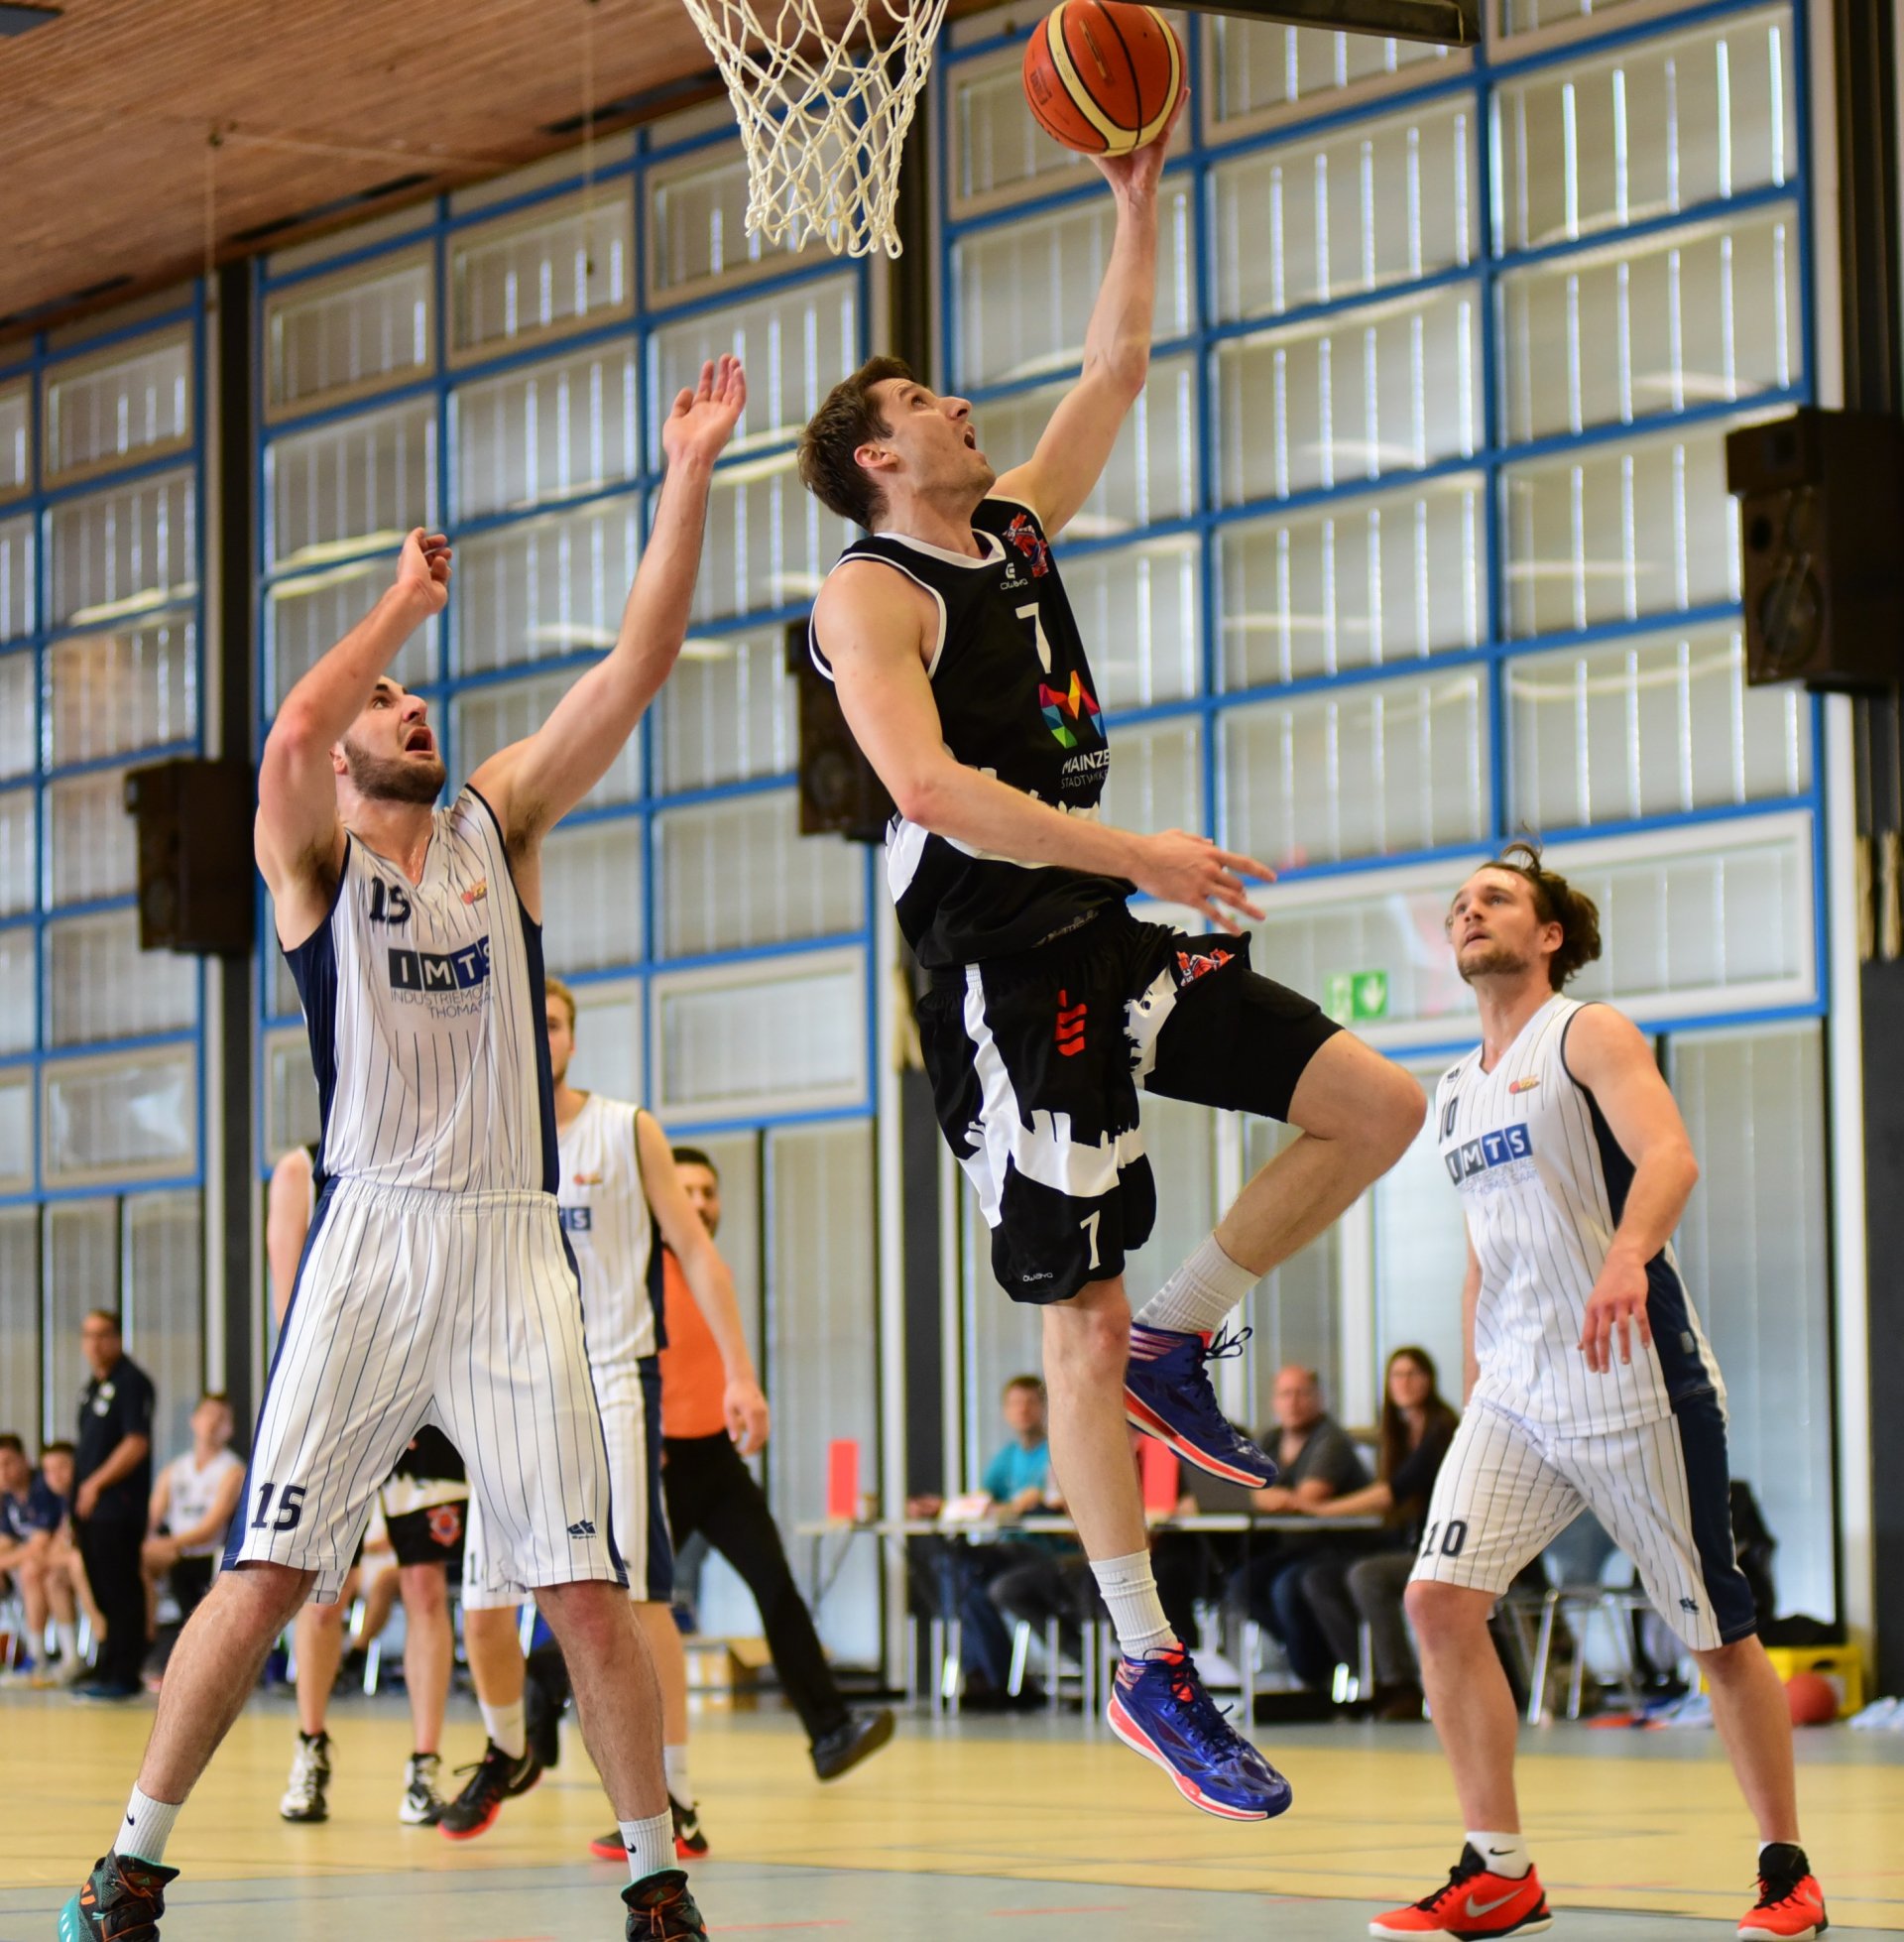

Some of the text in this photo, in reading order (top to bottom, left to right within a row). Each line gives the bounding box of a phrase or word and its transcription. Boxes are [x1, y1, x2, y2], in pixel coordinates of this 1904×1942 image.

[1015, 602, 1052, 674] 7
[369, 877, 412, 924] 15
[1448, 1129, 1526, 1179] IMTS
[1079, 1209, 1102, 1271] 7
[250, 1482, 307, 1531] 15
[1421, 1519, 1469, 1558] 10
